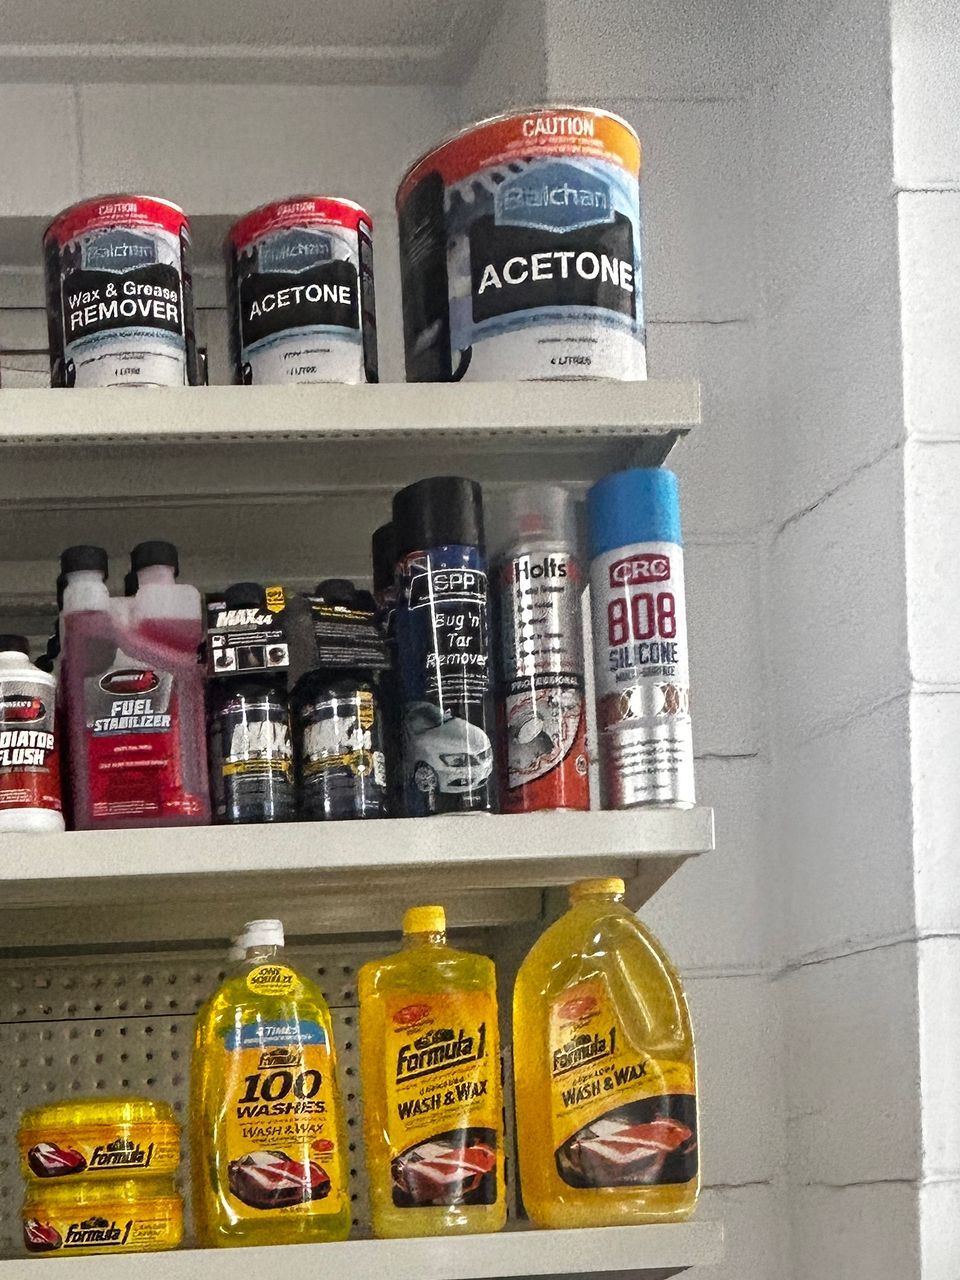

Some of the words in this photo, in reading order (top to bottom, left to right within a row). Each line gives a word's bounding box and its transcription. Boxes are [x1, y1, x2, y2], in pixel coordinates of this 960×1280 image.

[522, 117, 595, 137] CAUTION
[477, 250, 634, 295] ACETONE
[68, 289, 100, 310] Wax
[105, 282, 118, 298] &
[123, 281, 178, 303] Grease
[249, 283, 352, 321] ACETONE
[70, 298, 179, 332] REMOVER
[433, 572, 475, 591] SPP
[514, 557, 568, 584] Holts
[612, 559, 669, 583] CRC
[607, 591, 678, 647] 808
[446, 633, 473, 648] Tar
[426, 652, 489, 669] Remover
[111, 698, 154, 716] FUEL
[397, 1030, 474, 1077] Formula
[553, 1037, 607, 1071] Formula
[237, 1069, 323, 1104] 100
[562, 1081, 602, 1108] WASH
[613, 1061, 648, 1086] WAX
[236, 1100, 327, 1119] WASHES
[398, 1094, 441, 1120] WASH
[455, 1079, 488, 1102] WAX
[242, 1125, 282, 1139] WASH
[89, 1143, 145, 1166] Formula
[64, 1220, 121, 1243] Formula
